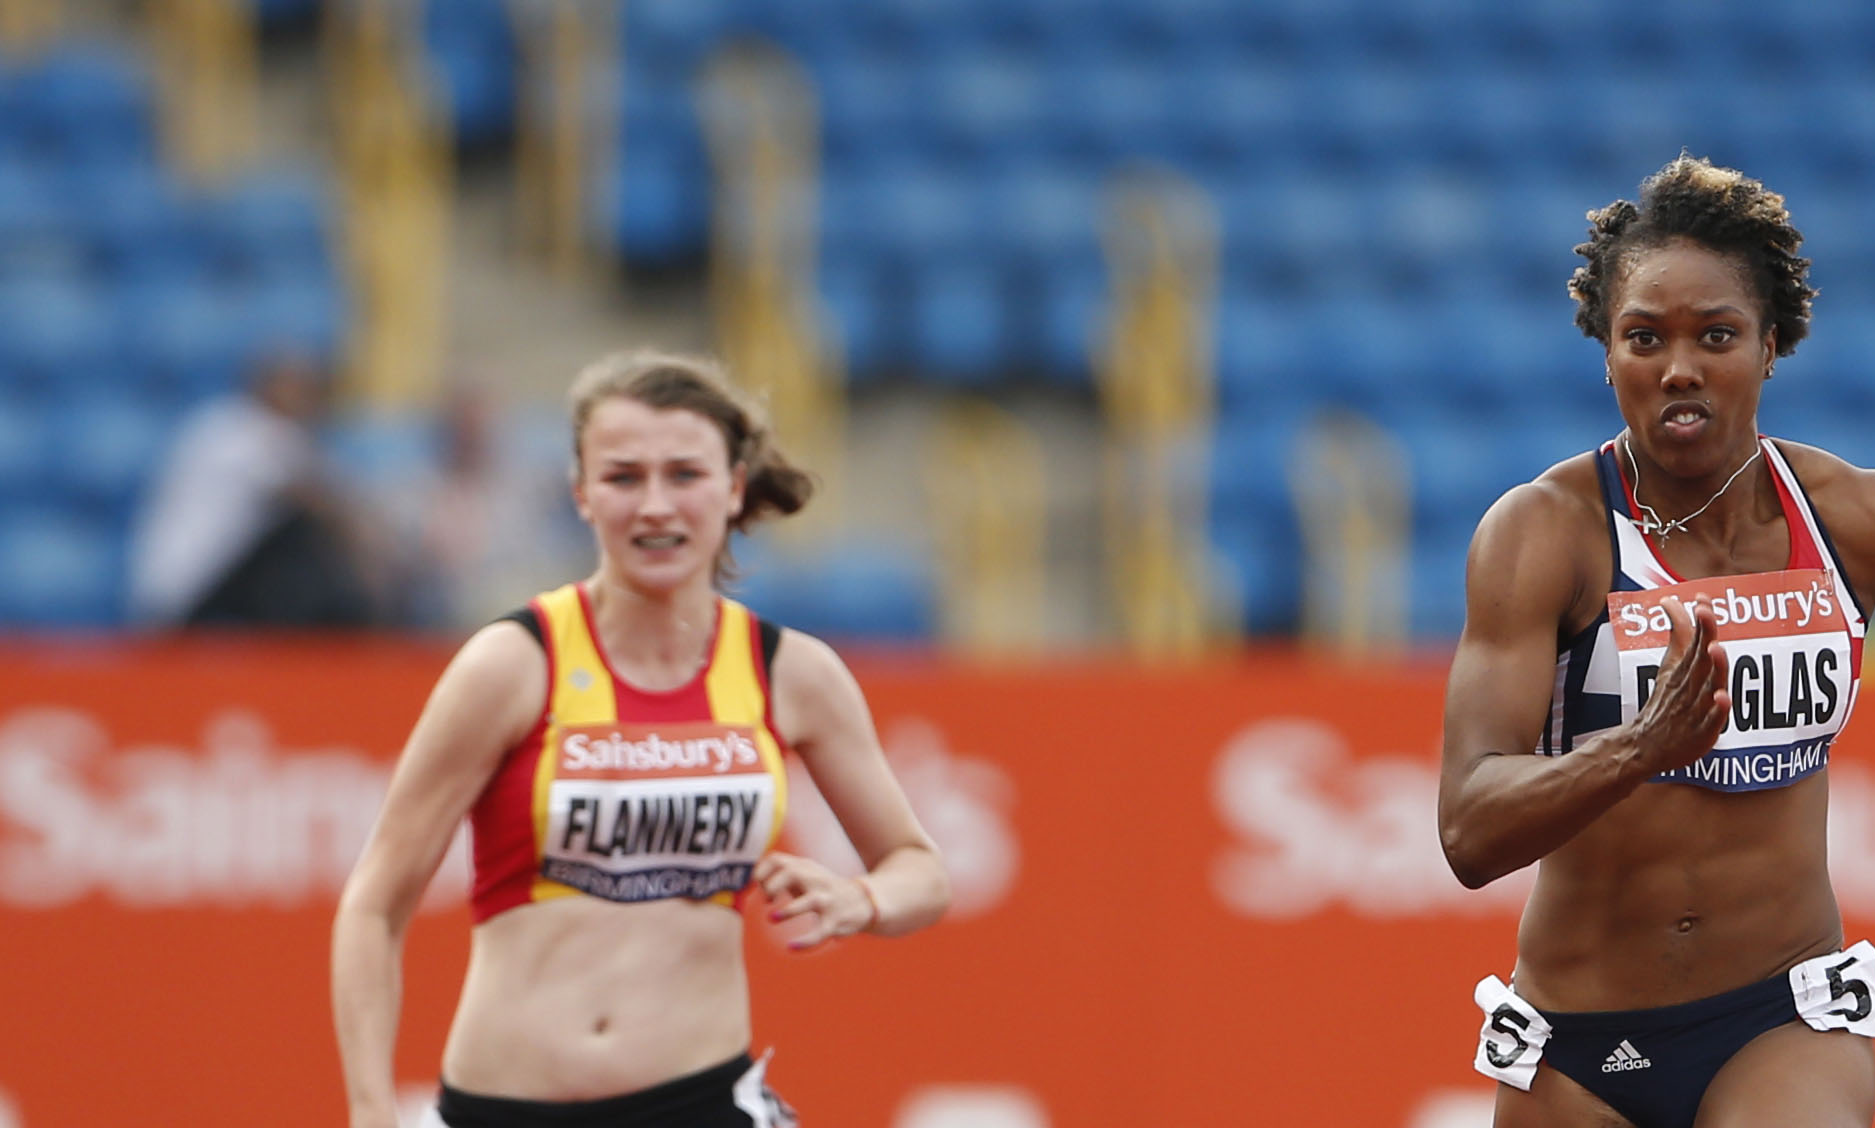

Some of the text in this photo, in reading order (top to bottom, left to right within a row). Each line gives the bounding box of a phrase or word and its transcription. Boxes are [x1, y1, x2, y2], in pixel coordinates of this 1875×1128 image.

[562, 731, 759, 774] Sainsbury's
[561, 792, 760, 858] FLANNERY
[1824, 957, 1873, 1023] 5
[1486, 1002, 1531, 1069] 5
[1601, 1056, 1652, 1074] adidas
